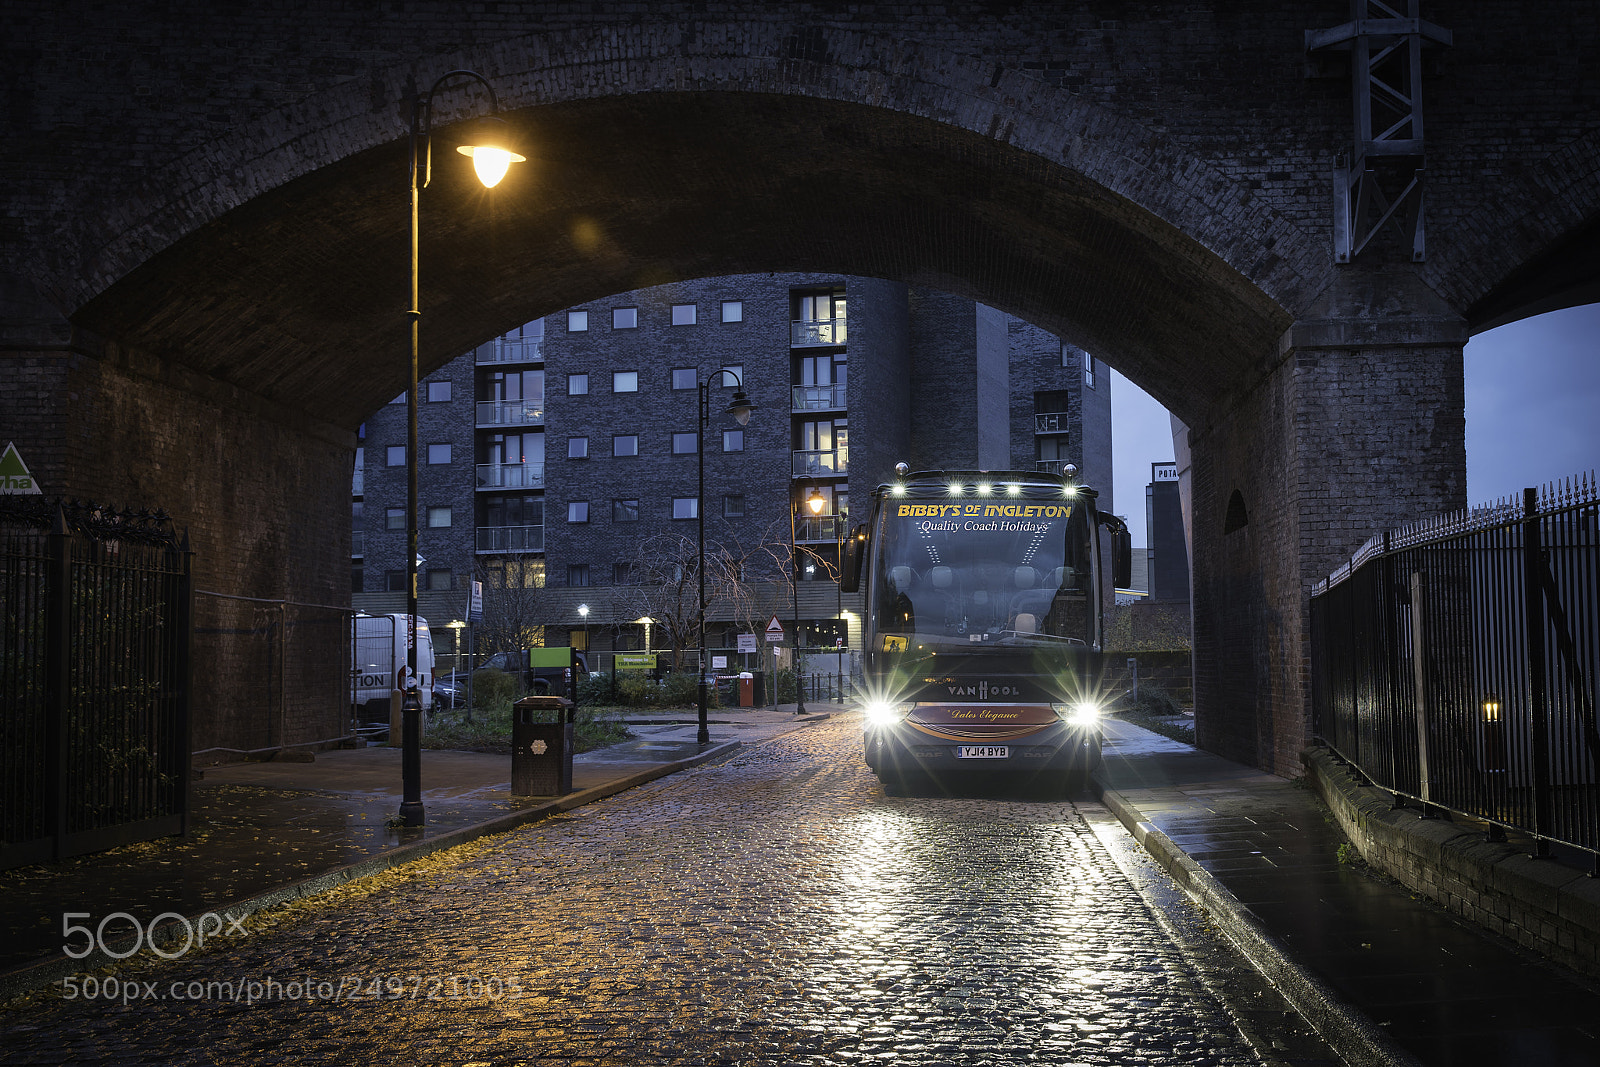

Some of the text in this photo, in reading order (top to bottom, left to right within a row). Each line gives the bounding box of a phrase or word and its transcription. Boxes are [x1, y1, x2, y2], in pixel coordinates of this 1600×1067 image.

[1159, 469, 1177, 478] POTA
[897, 504, 1072, 518] BIBBY'S OF INGLETON
[921, 520, 1049, 533] Quality Coach Holidays
[965, 747, 1006, 756] YJ14 BYB
